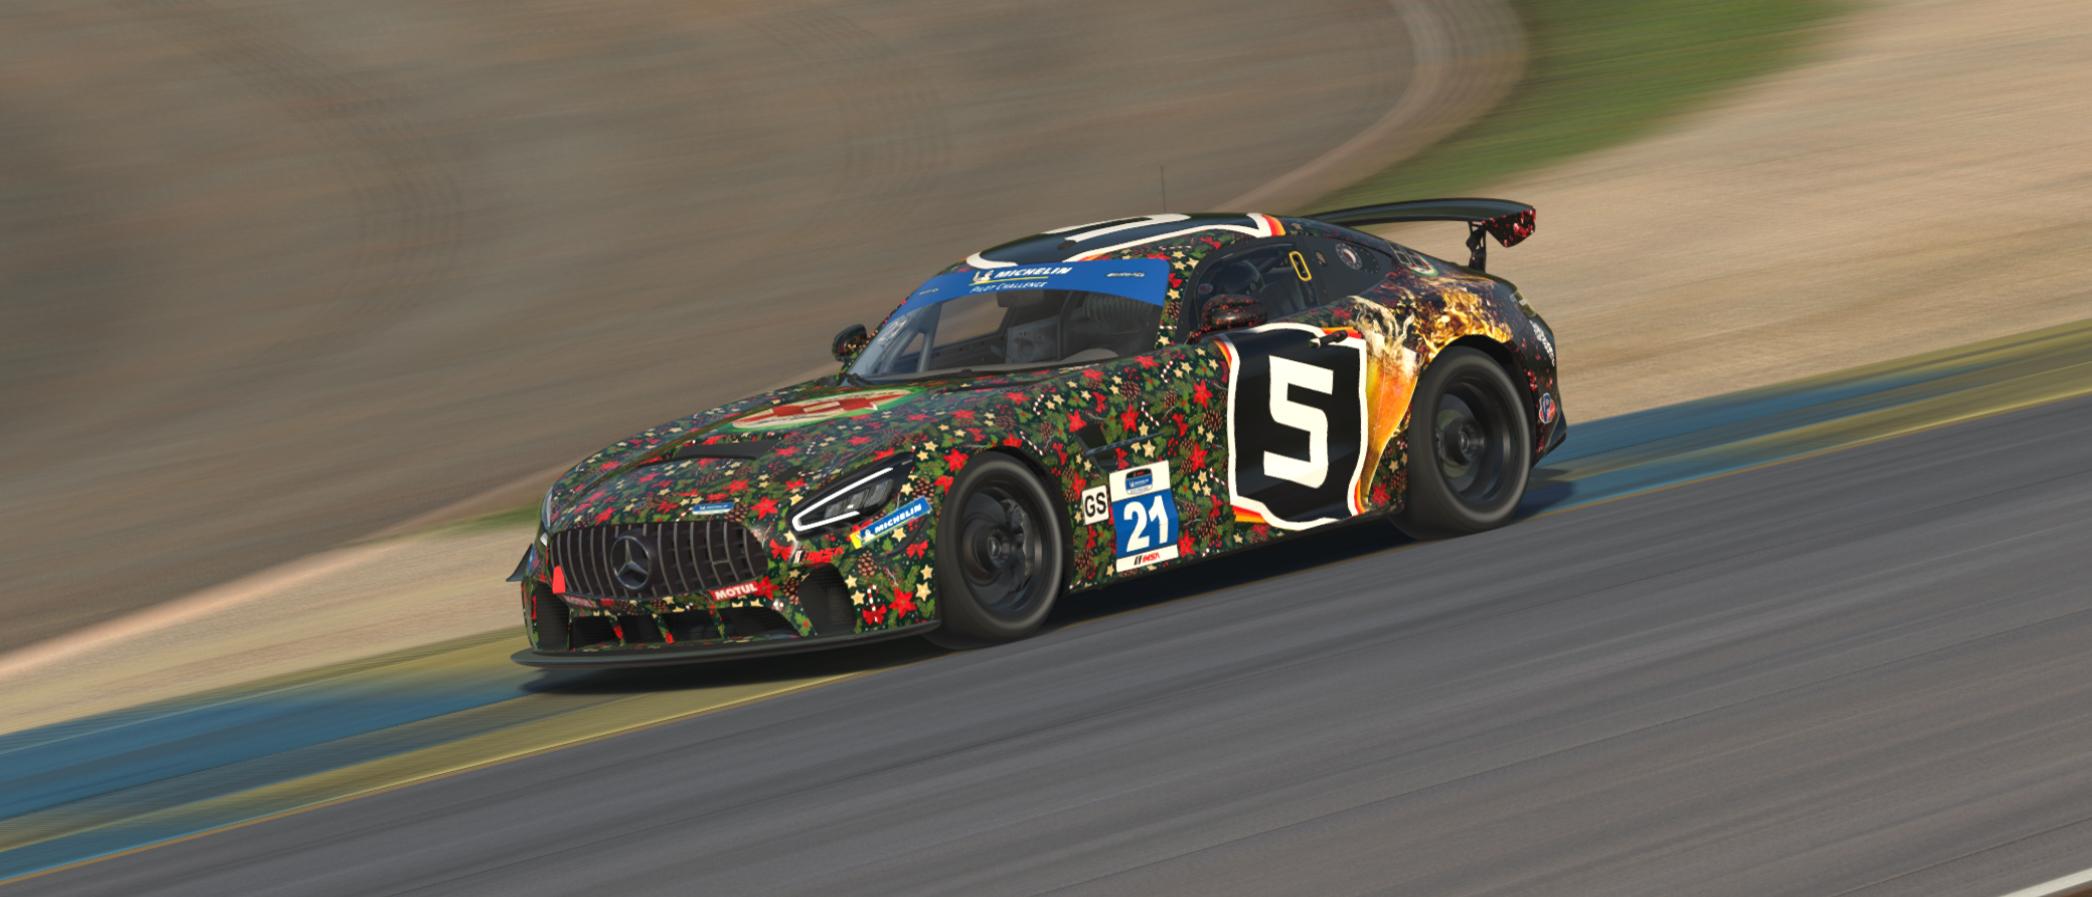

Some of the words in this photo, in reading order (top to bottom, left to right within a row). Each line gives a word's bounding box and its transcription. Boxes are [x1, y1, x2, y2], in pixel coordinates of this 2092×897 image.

[994, 266, 1072, 279] MICHELIN
[1263, 355, 1334, 489] 5
[874, 503, 922, 534] MICHELIN
[1084, 492, 1107, 518] GS
[1123, 494, 1169, 553] 21
[714, 583, 758, 600] MOTUL
